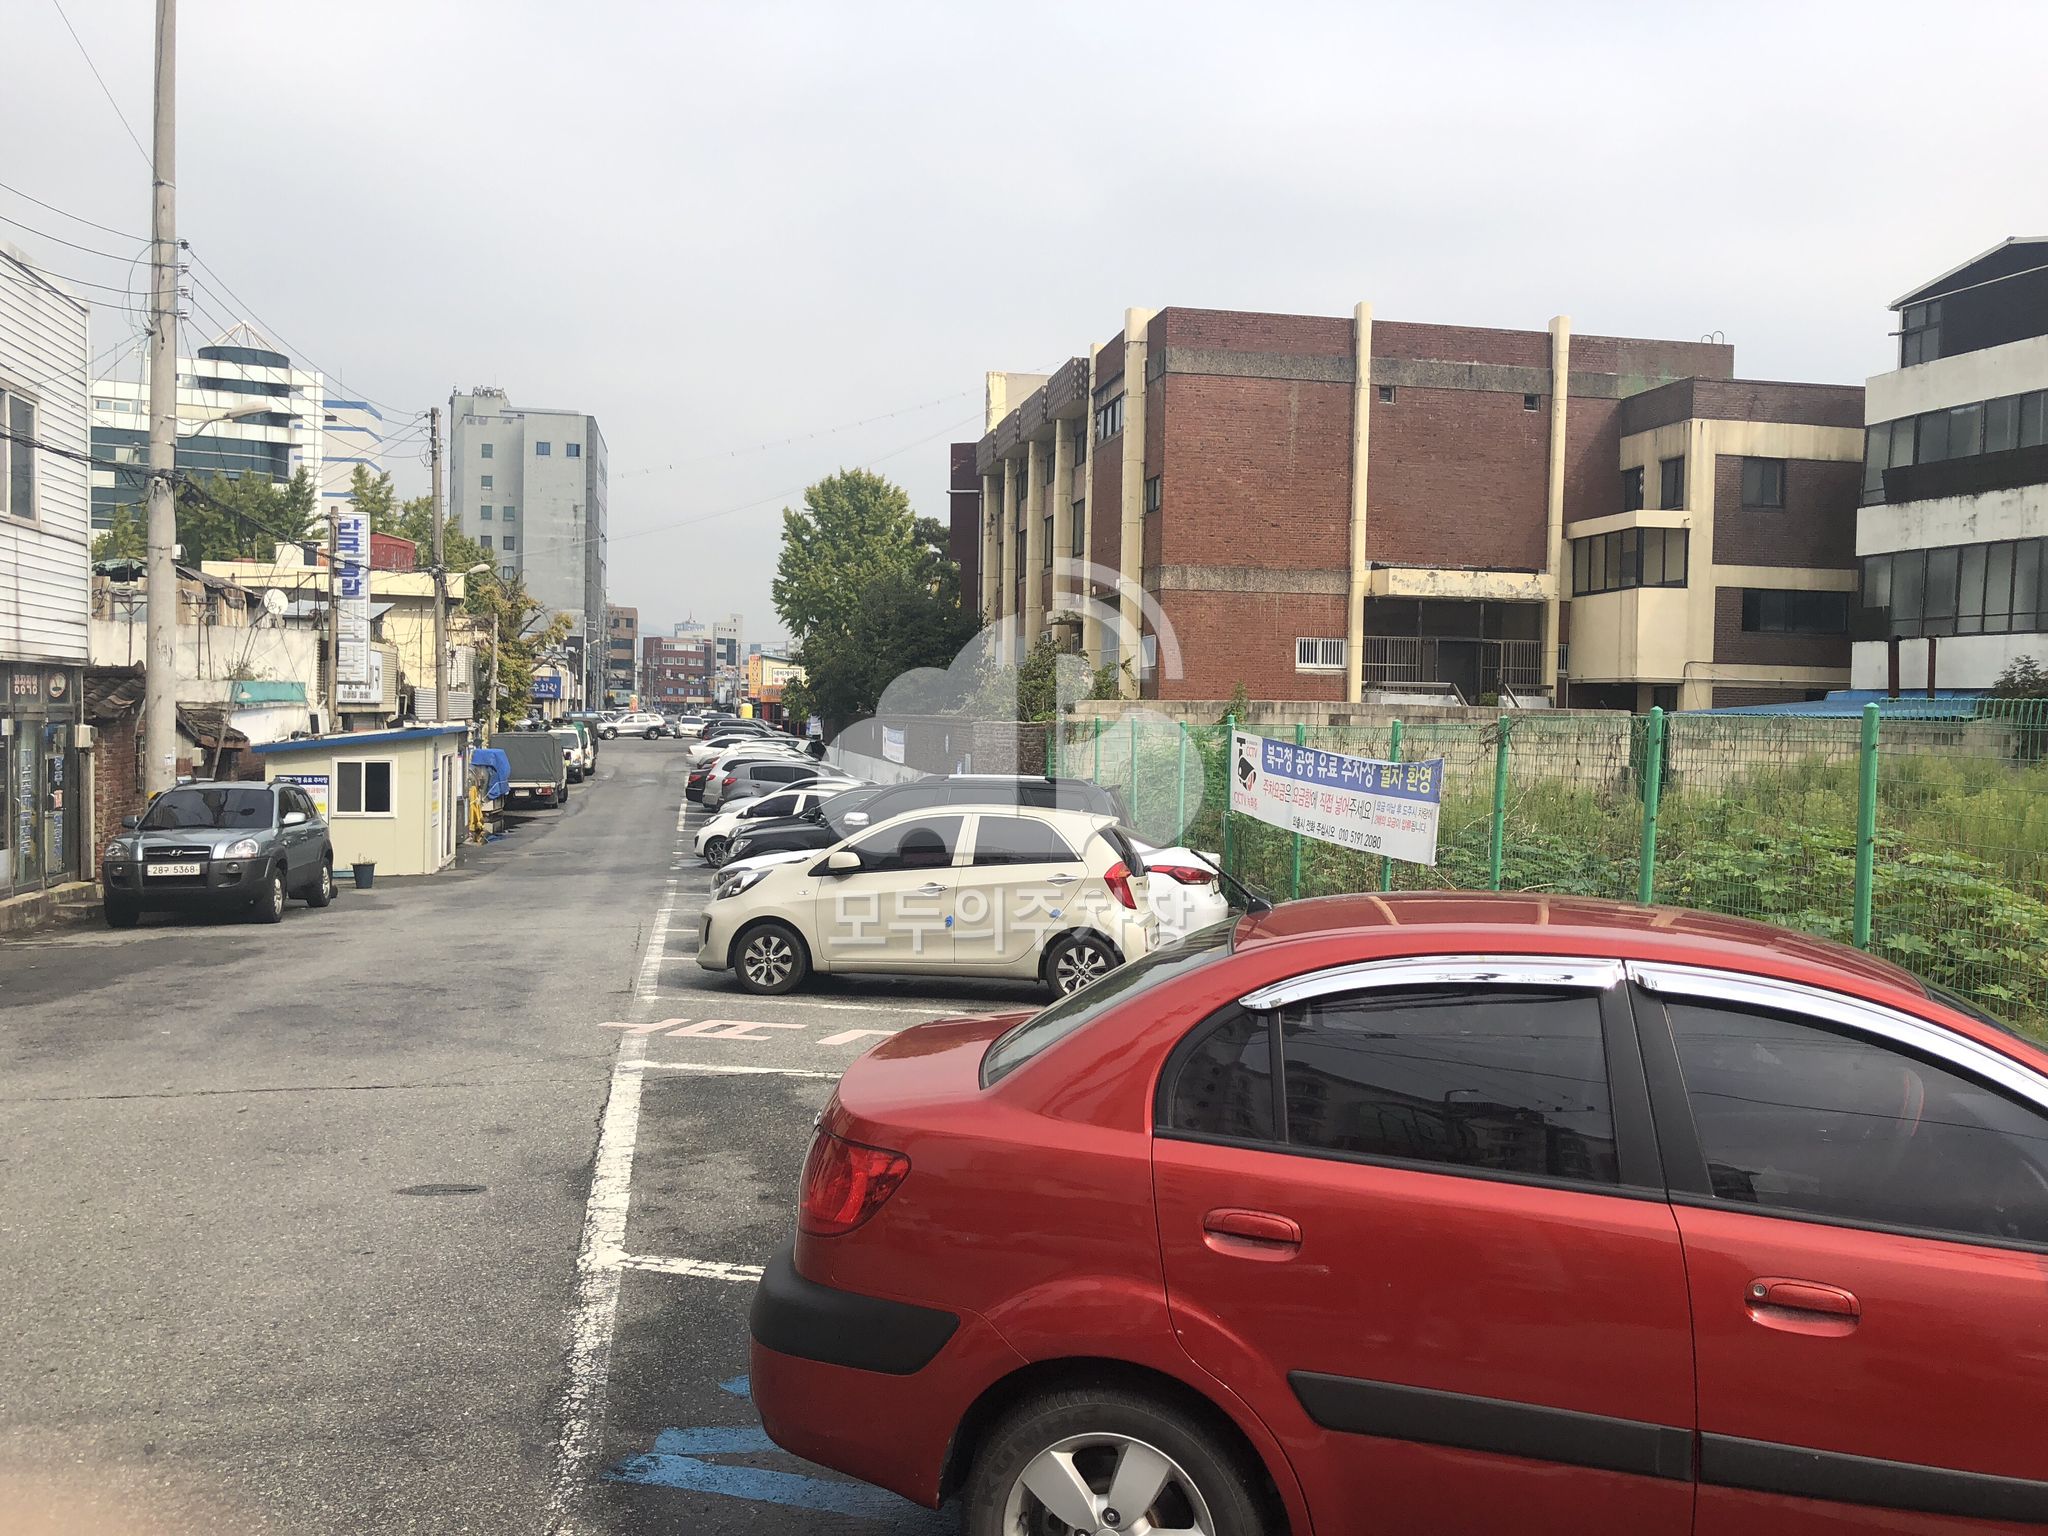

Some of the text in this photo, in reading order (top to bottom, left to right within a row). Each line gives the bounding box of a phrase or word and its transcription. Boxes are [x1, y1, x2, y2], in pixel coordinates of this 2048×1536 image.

[1266, 743, 1293, 774] 북구청
[1295, 751, 1315, 778] 공영
[1317, 756, 1338, 778] 유료
[1341, 757, 1376, 788] 주차장
[1406, 765, 1432, 794] 환영
[1262, 778, 1292, 803] 주차요금은
[1319, 792, 1335, 813] 직접
[1338, 827, 1349, 842] 010
[1350, 830, 1363, 845] 5191
[1364, 834, 1382, 849] 2080
[173, 865, 195, 874] 5368
